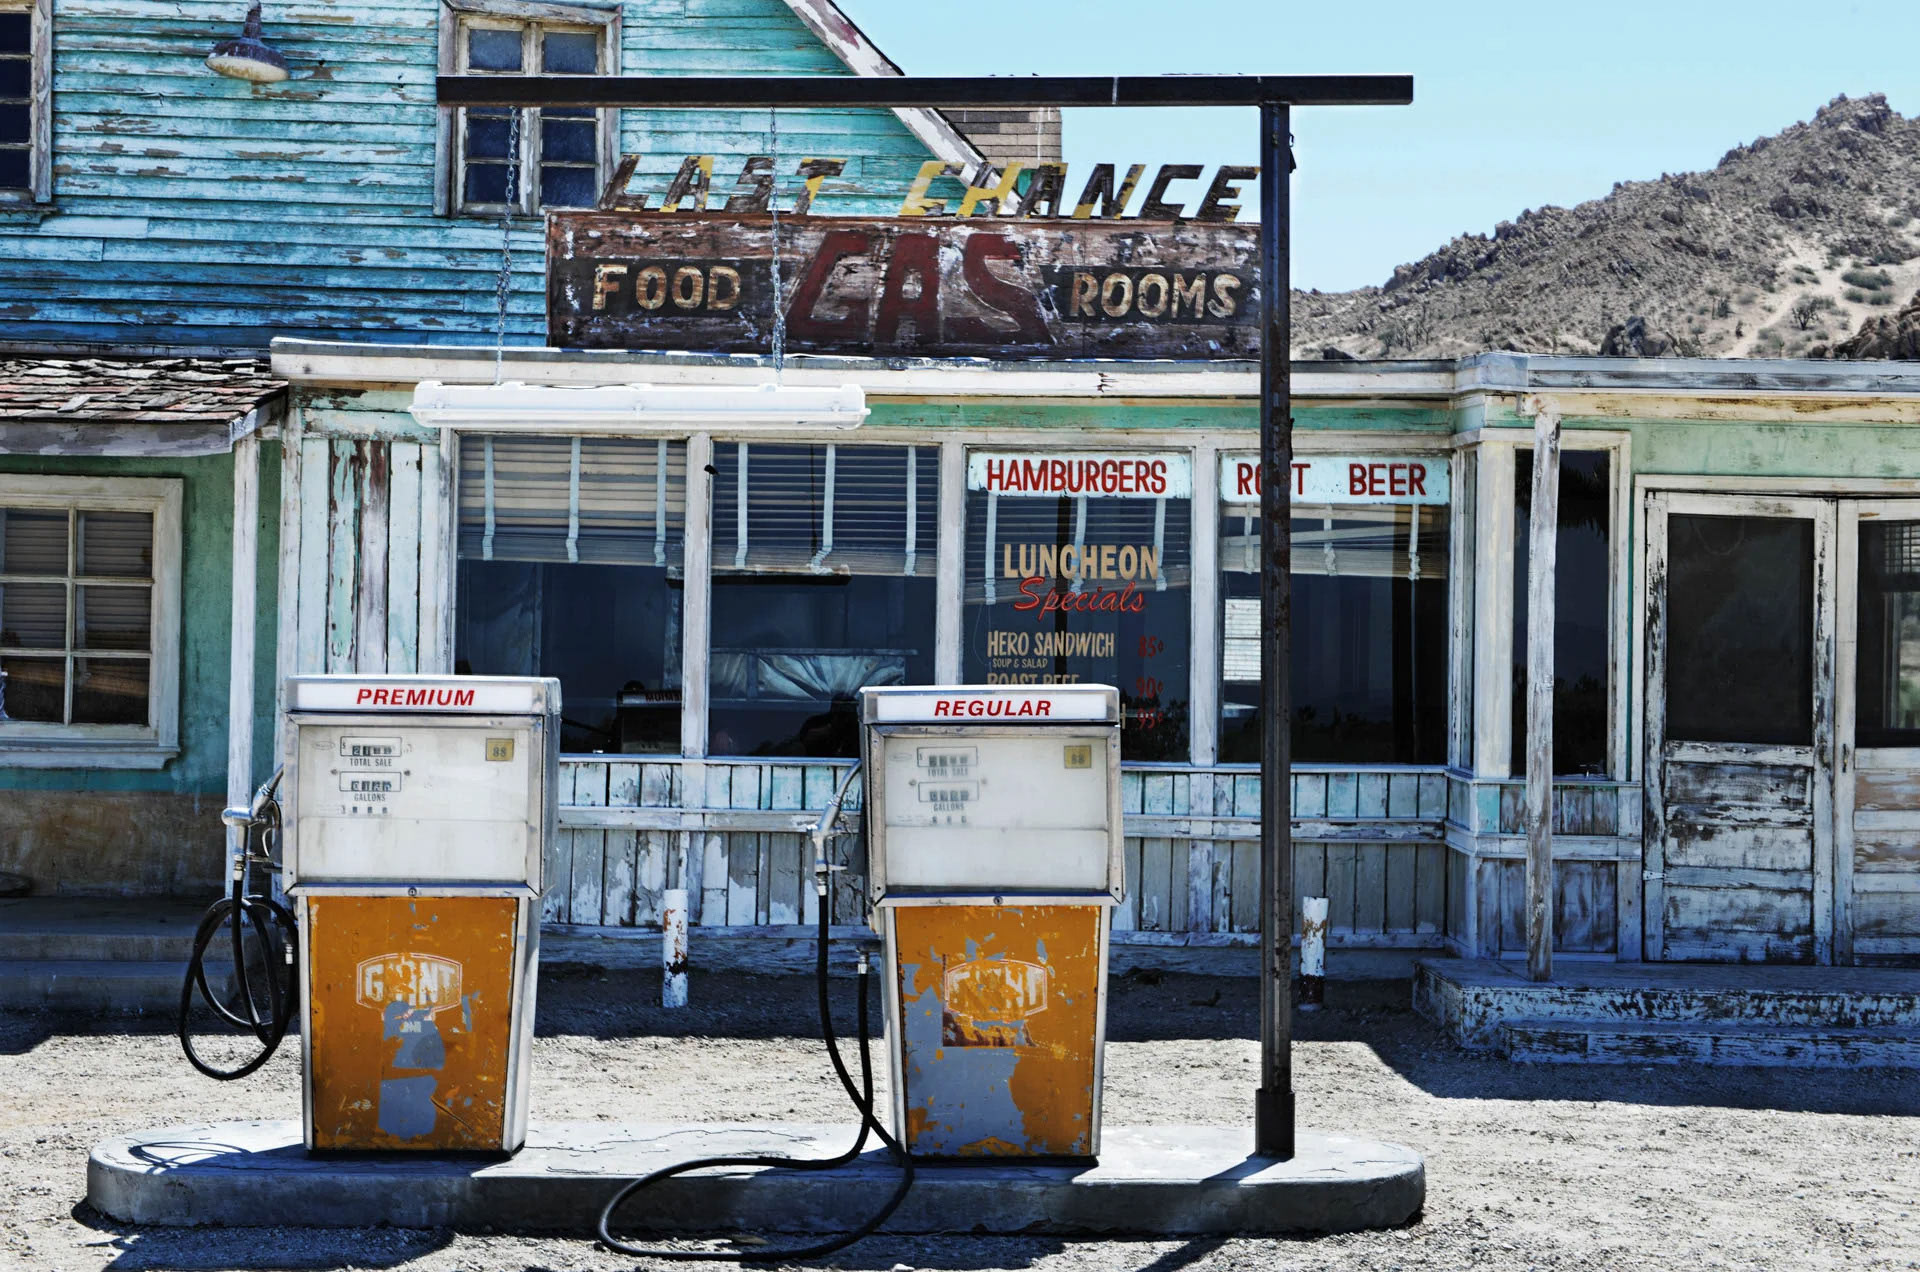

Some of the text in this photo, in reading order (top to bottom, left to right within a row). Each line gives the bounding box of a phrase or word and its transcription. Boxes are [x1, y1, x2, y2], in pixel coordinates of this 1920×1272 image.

[600, 154, 1260, 223] LAST CHANCE
[592, 231, 1240, 346] FOOD GAS ROOMS
[987, 459, 1167, 494] HAMBURGERS
[1237, 463, 1427, 496] RT BEER
[1003, 544, 1158, 580] LUNCHEON
[1014, 576, 1146, 622] Specials
[987, 630, 1029, 657] HERO
[1034, 630, 1115, 657] SANDWICH
[992, 658, 1012, 668] SOUP
[1022, 658, 1048, 669] SALAD
[356, 688, 475, 706] PREMIUM
[934, 700, 1051, 716] REGULAR
[350, 758, 392, 767] TOTAL SALE
[354, 793, 386, 802] GALLONS
